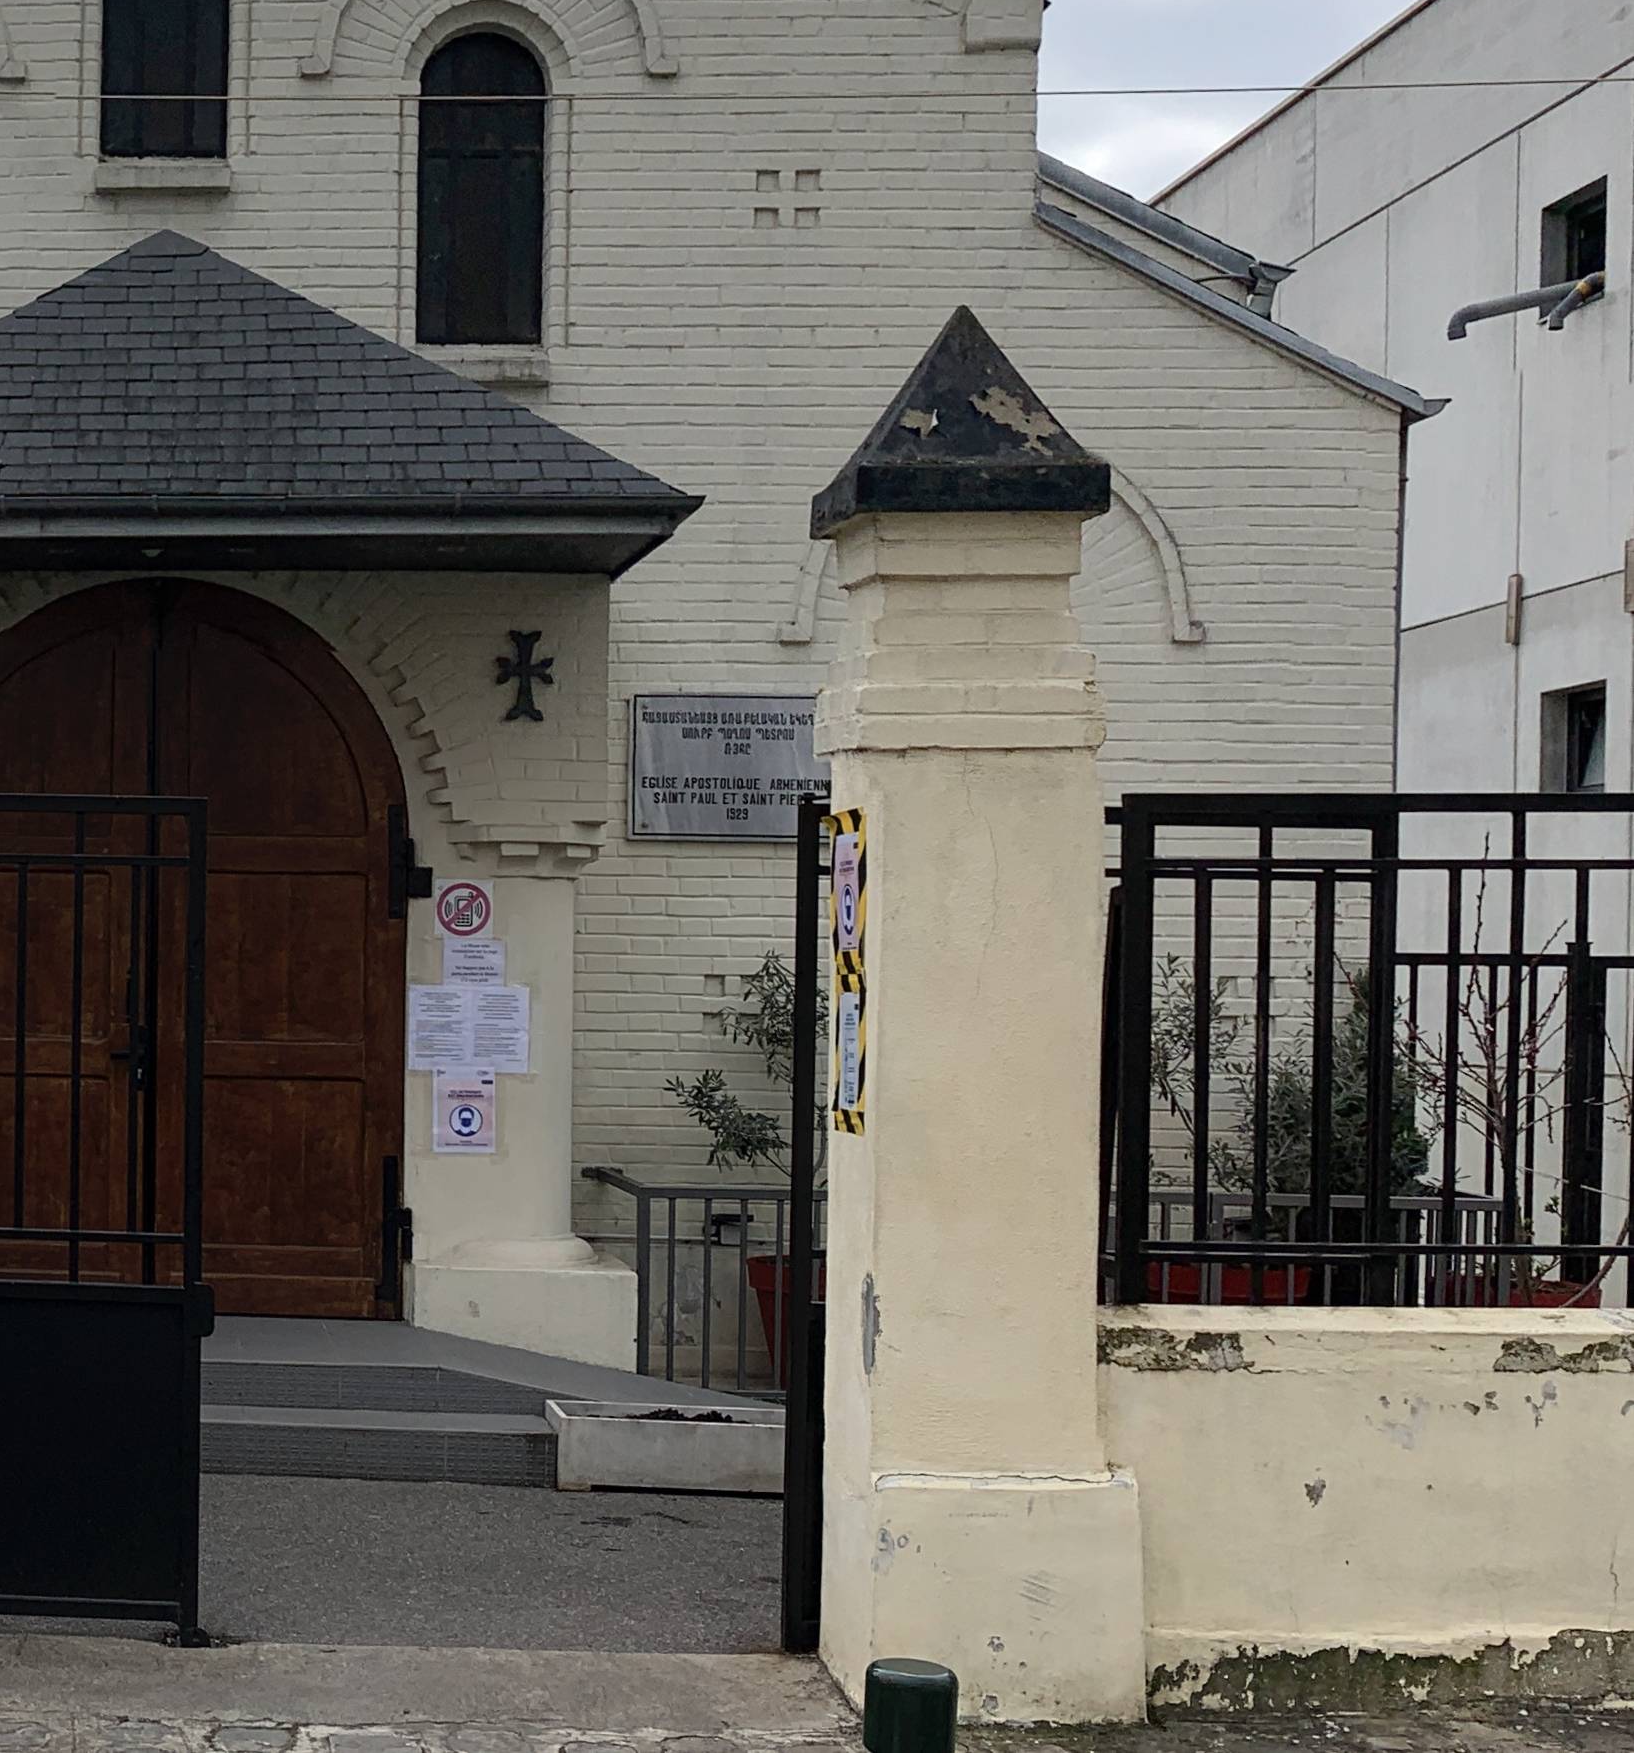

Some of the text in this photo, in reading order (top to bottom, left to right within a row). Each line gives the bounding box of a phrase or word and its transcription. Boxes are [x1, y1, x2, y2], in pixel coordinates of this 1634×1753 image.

[690, 792, 719, 804] PAUL
[722, 792, 739, 804] ET
[726, 808, 749, 821] 1929
